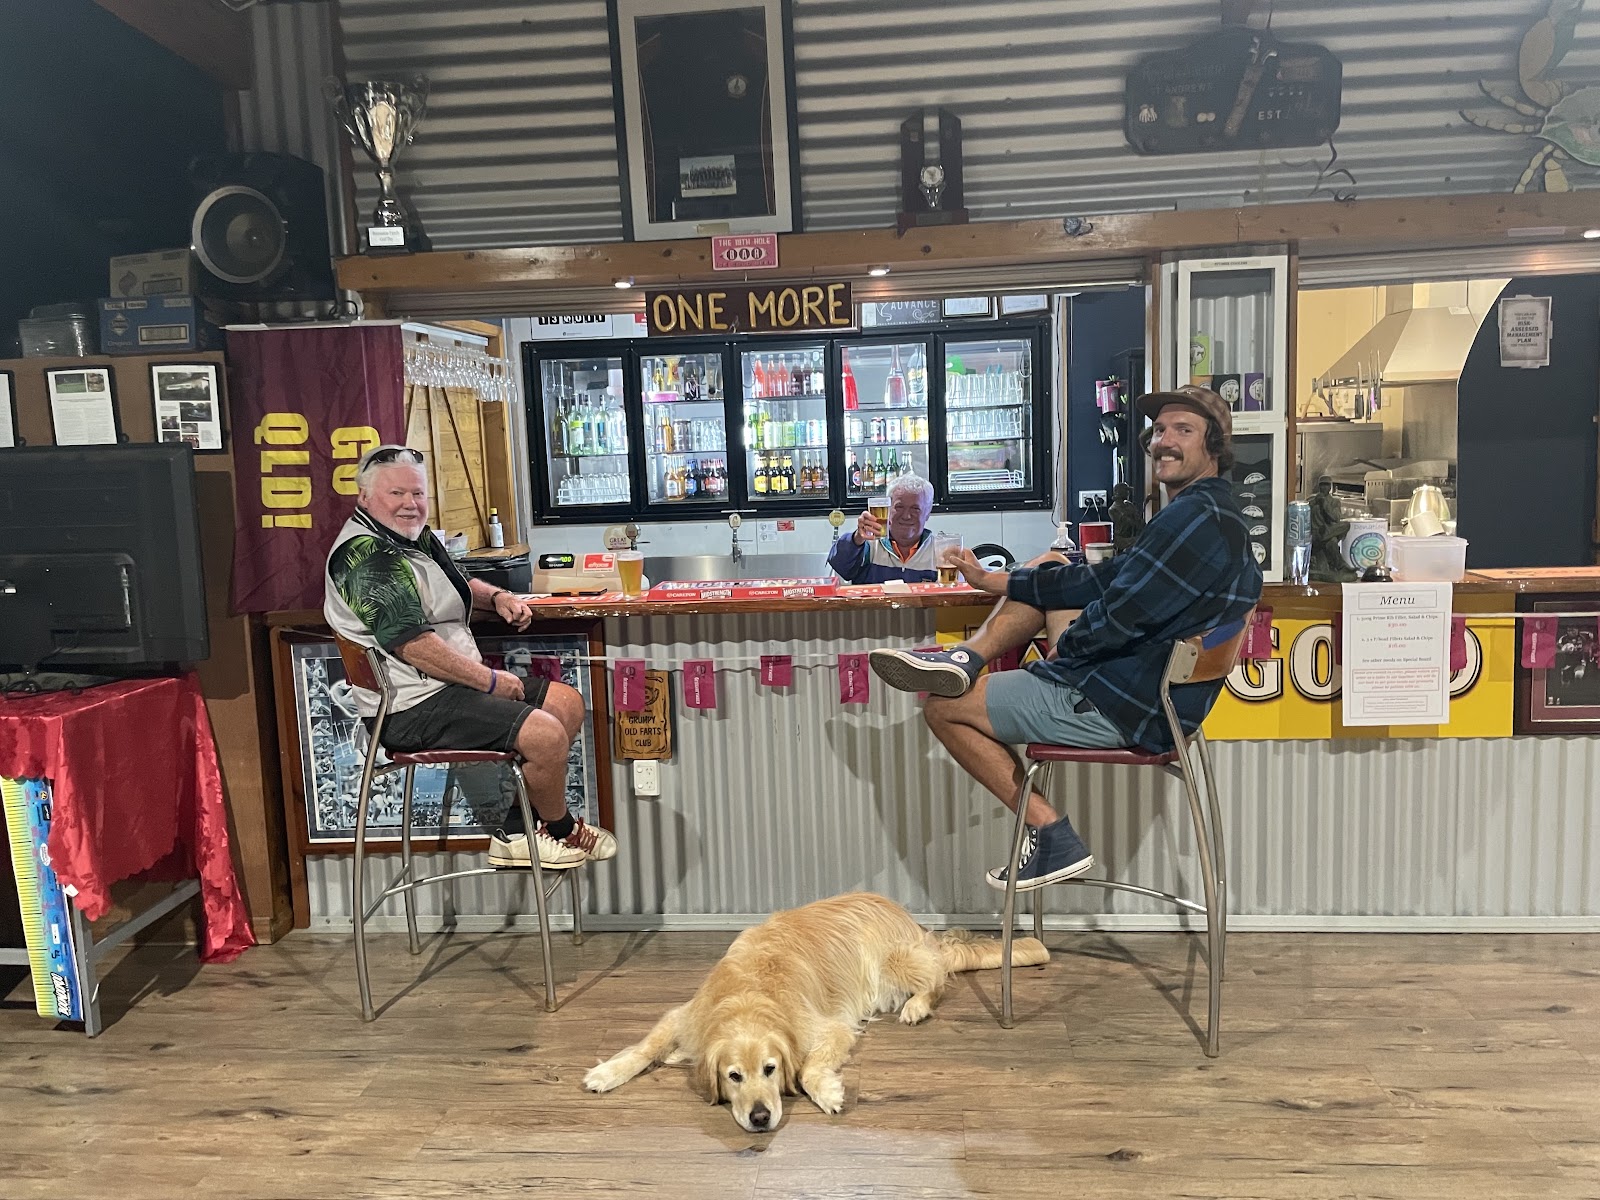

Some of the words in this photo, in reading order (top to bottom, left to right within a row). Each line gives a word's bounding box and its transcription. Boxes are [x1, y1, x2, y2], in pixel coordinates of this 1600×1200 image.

[1258, 109, 1281, 121] EST
[753, 236, 771, 245] HOLE
[652, 292, 728, 333] ONE
[748, 283, 850, 329] MORE
[254, 412, 313, 529] QLD!
[1379, 595, 1416, 606] Menu
[628, 715, 656, 724] GRUMPY
[624, 727, 638, 736] OLD
[639, 727, 662, 736] FARTS
[634, 739, 652, 747] CLUB
